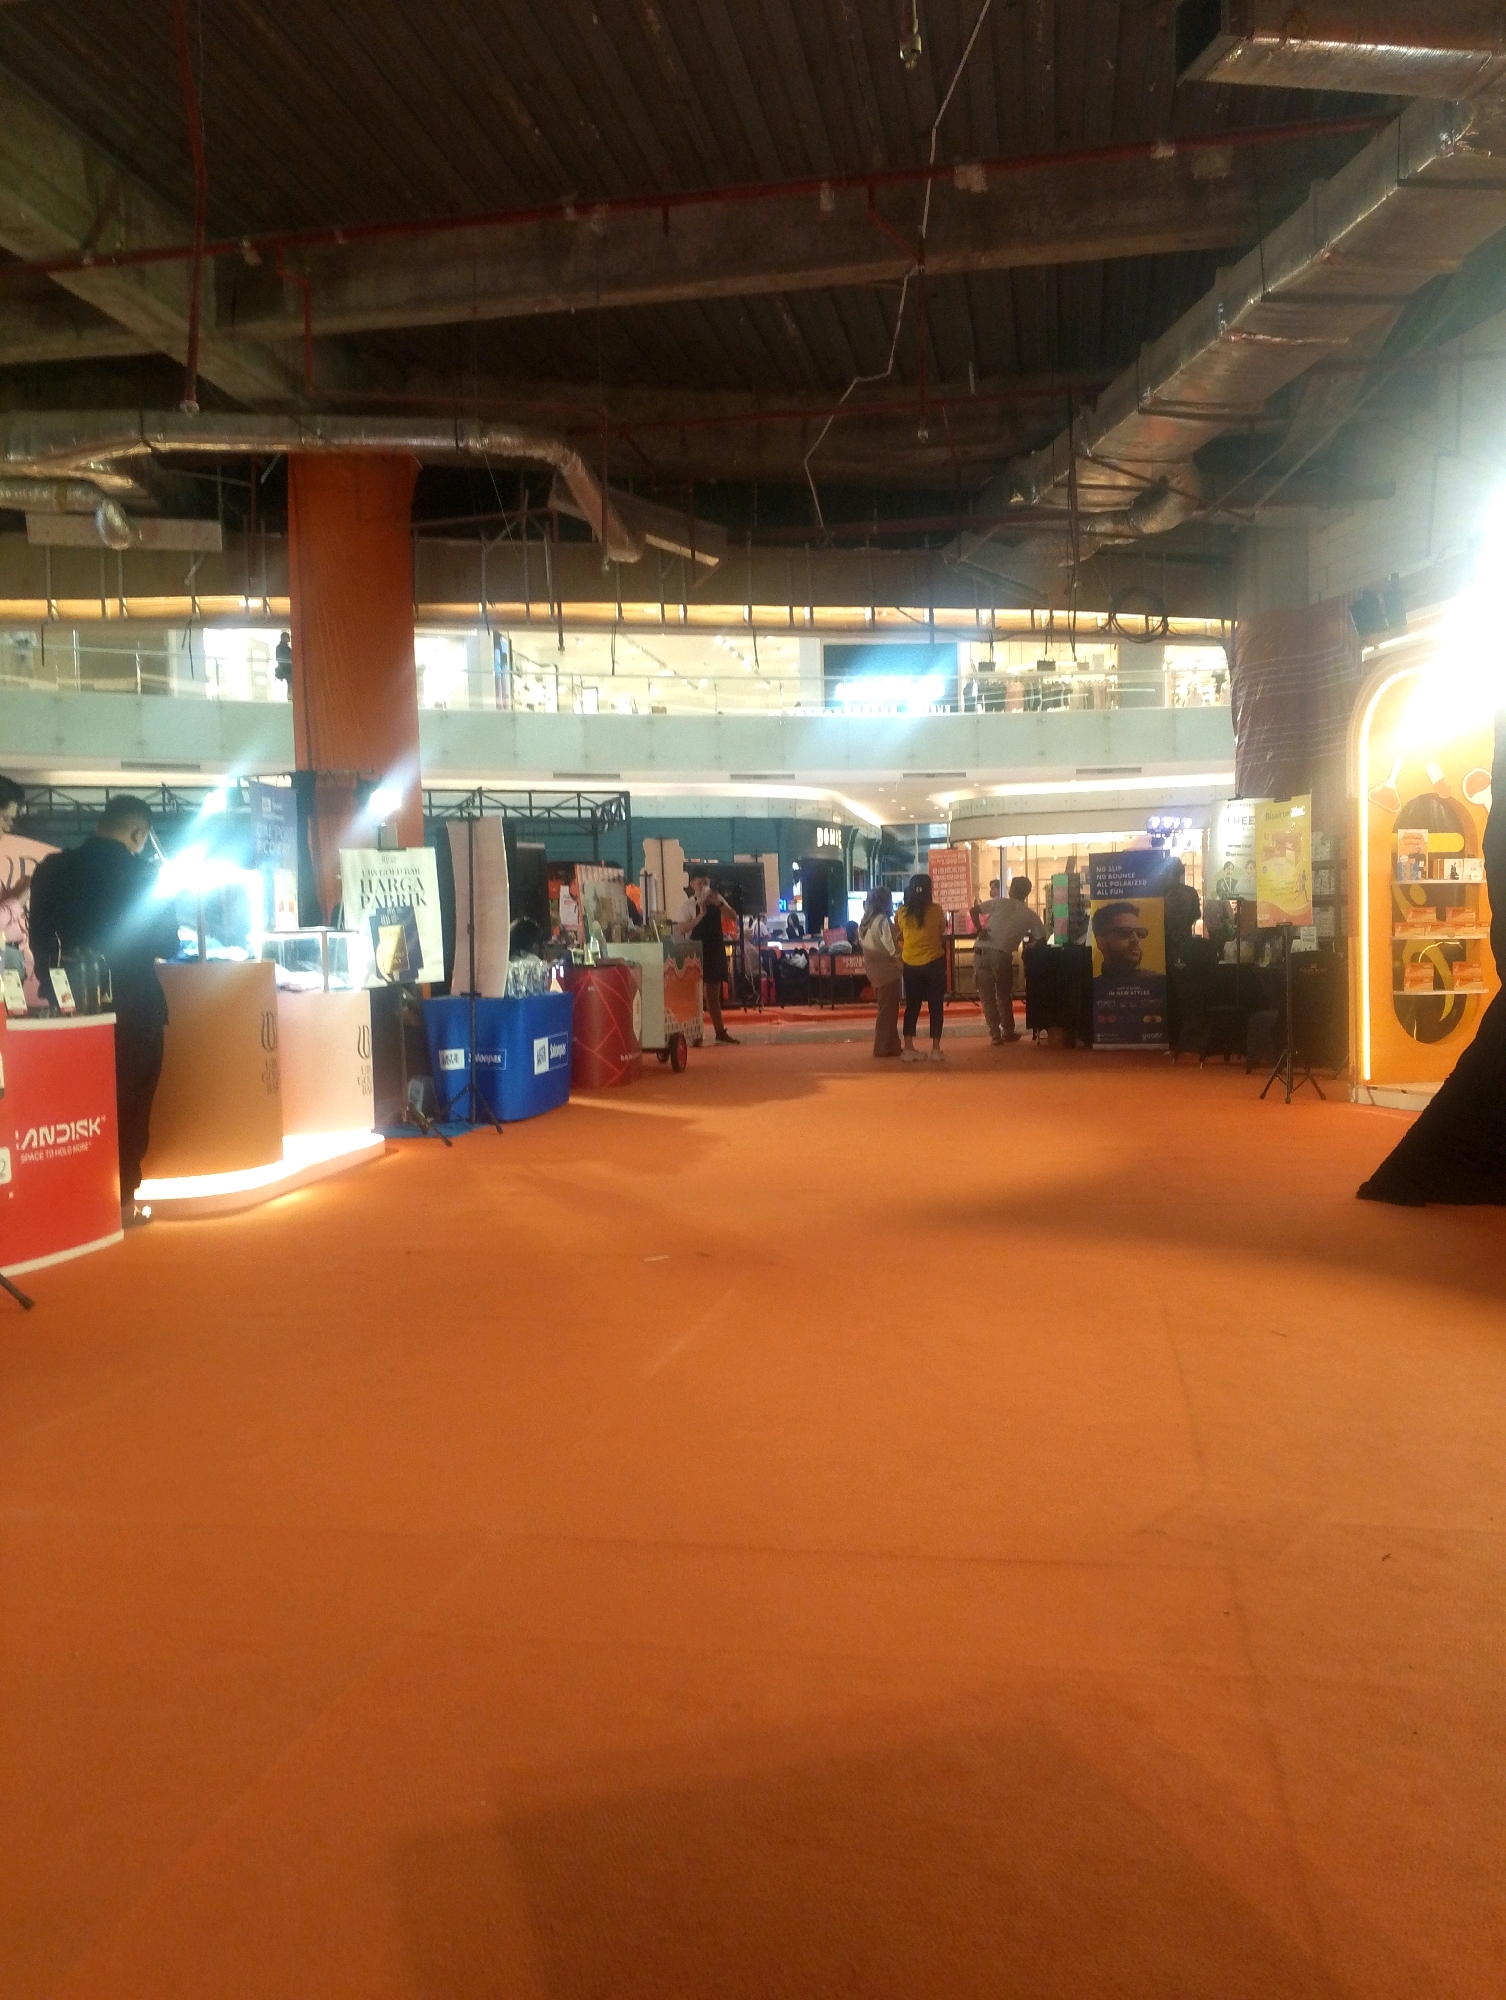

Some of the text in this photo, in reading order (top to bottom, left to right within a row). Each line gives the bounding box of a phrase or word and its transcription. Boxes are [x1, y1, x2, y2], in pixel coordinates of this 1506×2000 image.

[380, 868, 403, 876] GOLD
[405, 867, 420, 875] BAR
[360, 876, 425, 894] HARGA
[360, 892, 427, 909] PABRIK
[20, 1141, 89, 1165] SPACE TO HOLD MORE
